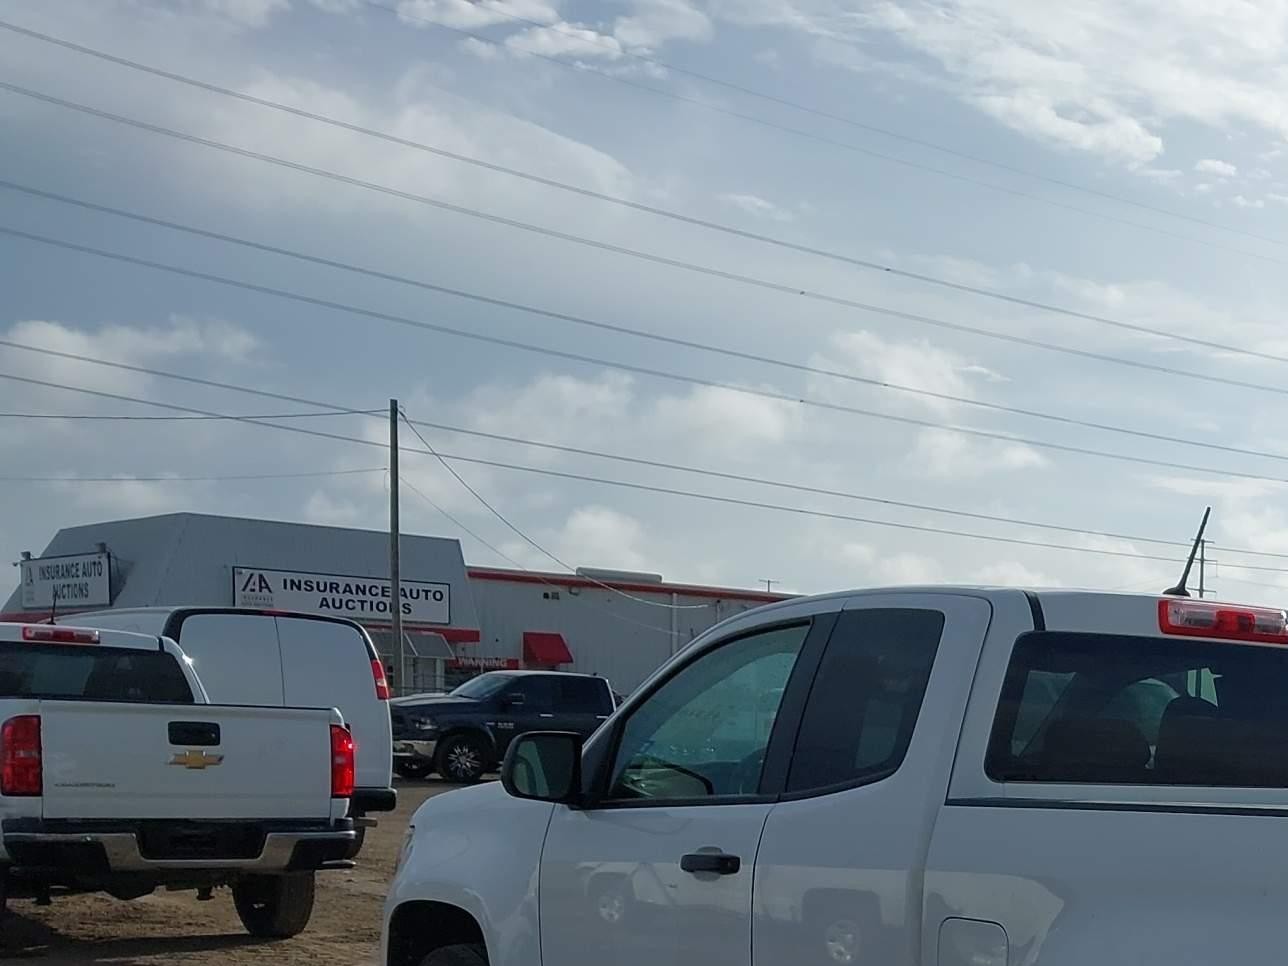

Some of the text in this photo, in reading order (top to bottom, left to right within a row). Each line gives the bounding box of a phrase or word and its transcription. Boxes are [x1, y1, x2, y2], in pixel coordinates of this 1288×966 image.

[38, 560, 103, 580] INSURANCE AUTO
[282, 578, 391, 598] INSURANCE
